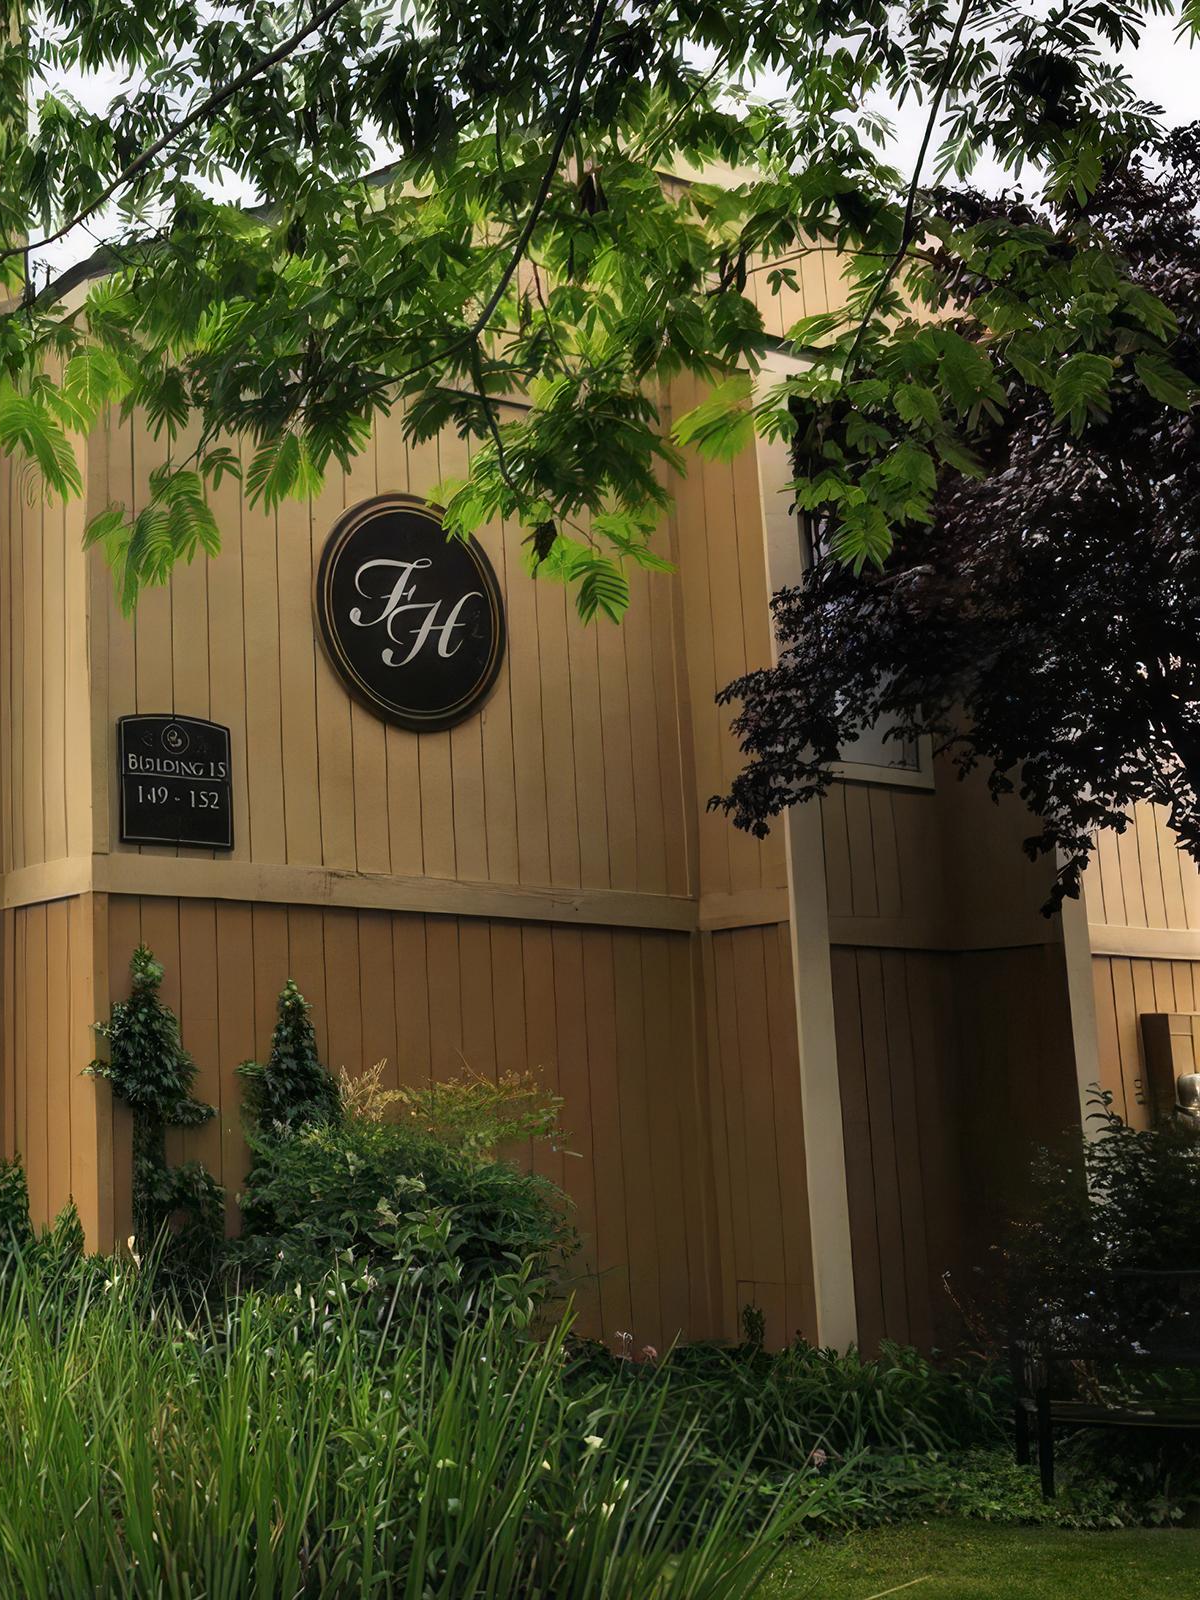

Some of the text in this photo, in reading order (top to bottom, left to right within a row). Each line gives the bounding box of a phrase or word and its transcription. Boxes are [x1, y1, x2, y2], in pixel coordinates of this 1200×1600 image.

[210, 762, 226, 778] 15
[138, 785, 168, 804] 149
[190, 790, 219, 809] 152
